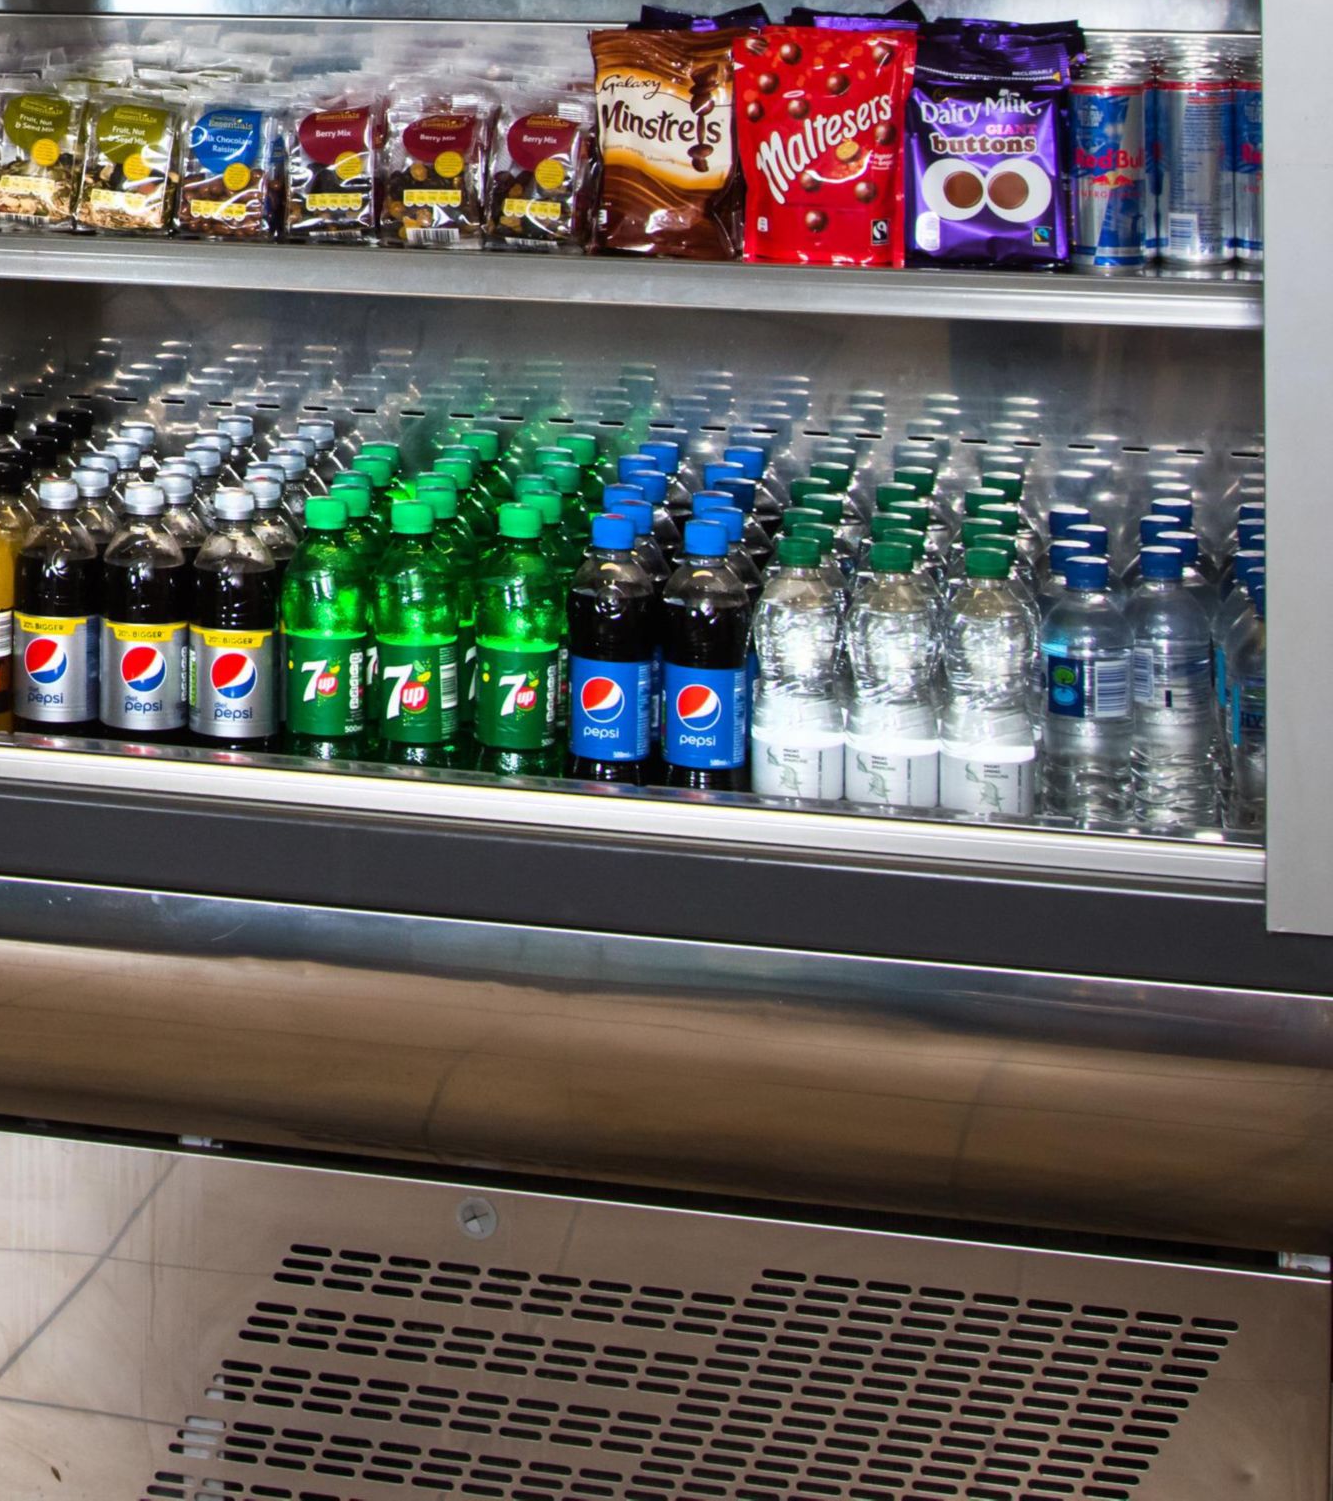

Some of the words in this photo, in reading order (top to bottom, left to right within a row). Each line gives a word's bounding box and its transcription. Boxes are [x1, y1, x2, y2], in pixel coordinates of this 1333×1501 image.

[599, 74, 661, 100] Galaxy
[921, 101, 982, 127] Dairy
[985, 97, 1042, 117] Milk
[601, 100, 722, 144] Minstrels
[112, 125, 130, 134] Fruit,
[132, 128, 146, 136] Nut
[315, 130, 336, 139] Berry
[985, 124, 1037, 135] GIANT
[215, 135, 253, 146] Chocolate
[420, 134, 440, 143] Berry
[522, 135, 542, 145] Berry
[543, 136, 557, 144] Mix
[930, 133, 1037, 155] buttons
[755, 94, 892, 205] Maltesers
[1075, 148, 1113, 169] Red
[35, 623, 64, 632] BIGGER
[133, 630, 162, 639] BIGGER
[222, 636, 253, 645] BIGGER
[28, 693, 63, 706] pepsi
[125, 701, 163, 714] pepsi
[214, 708, 253, 721] pepsi
[583, 726, 620, 740] pepsi
[679, 734, 716, 748] pepsi
